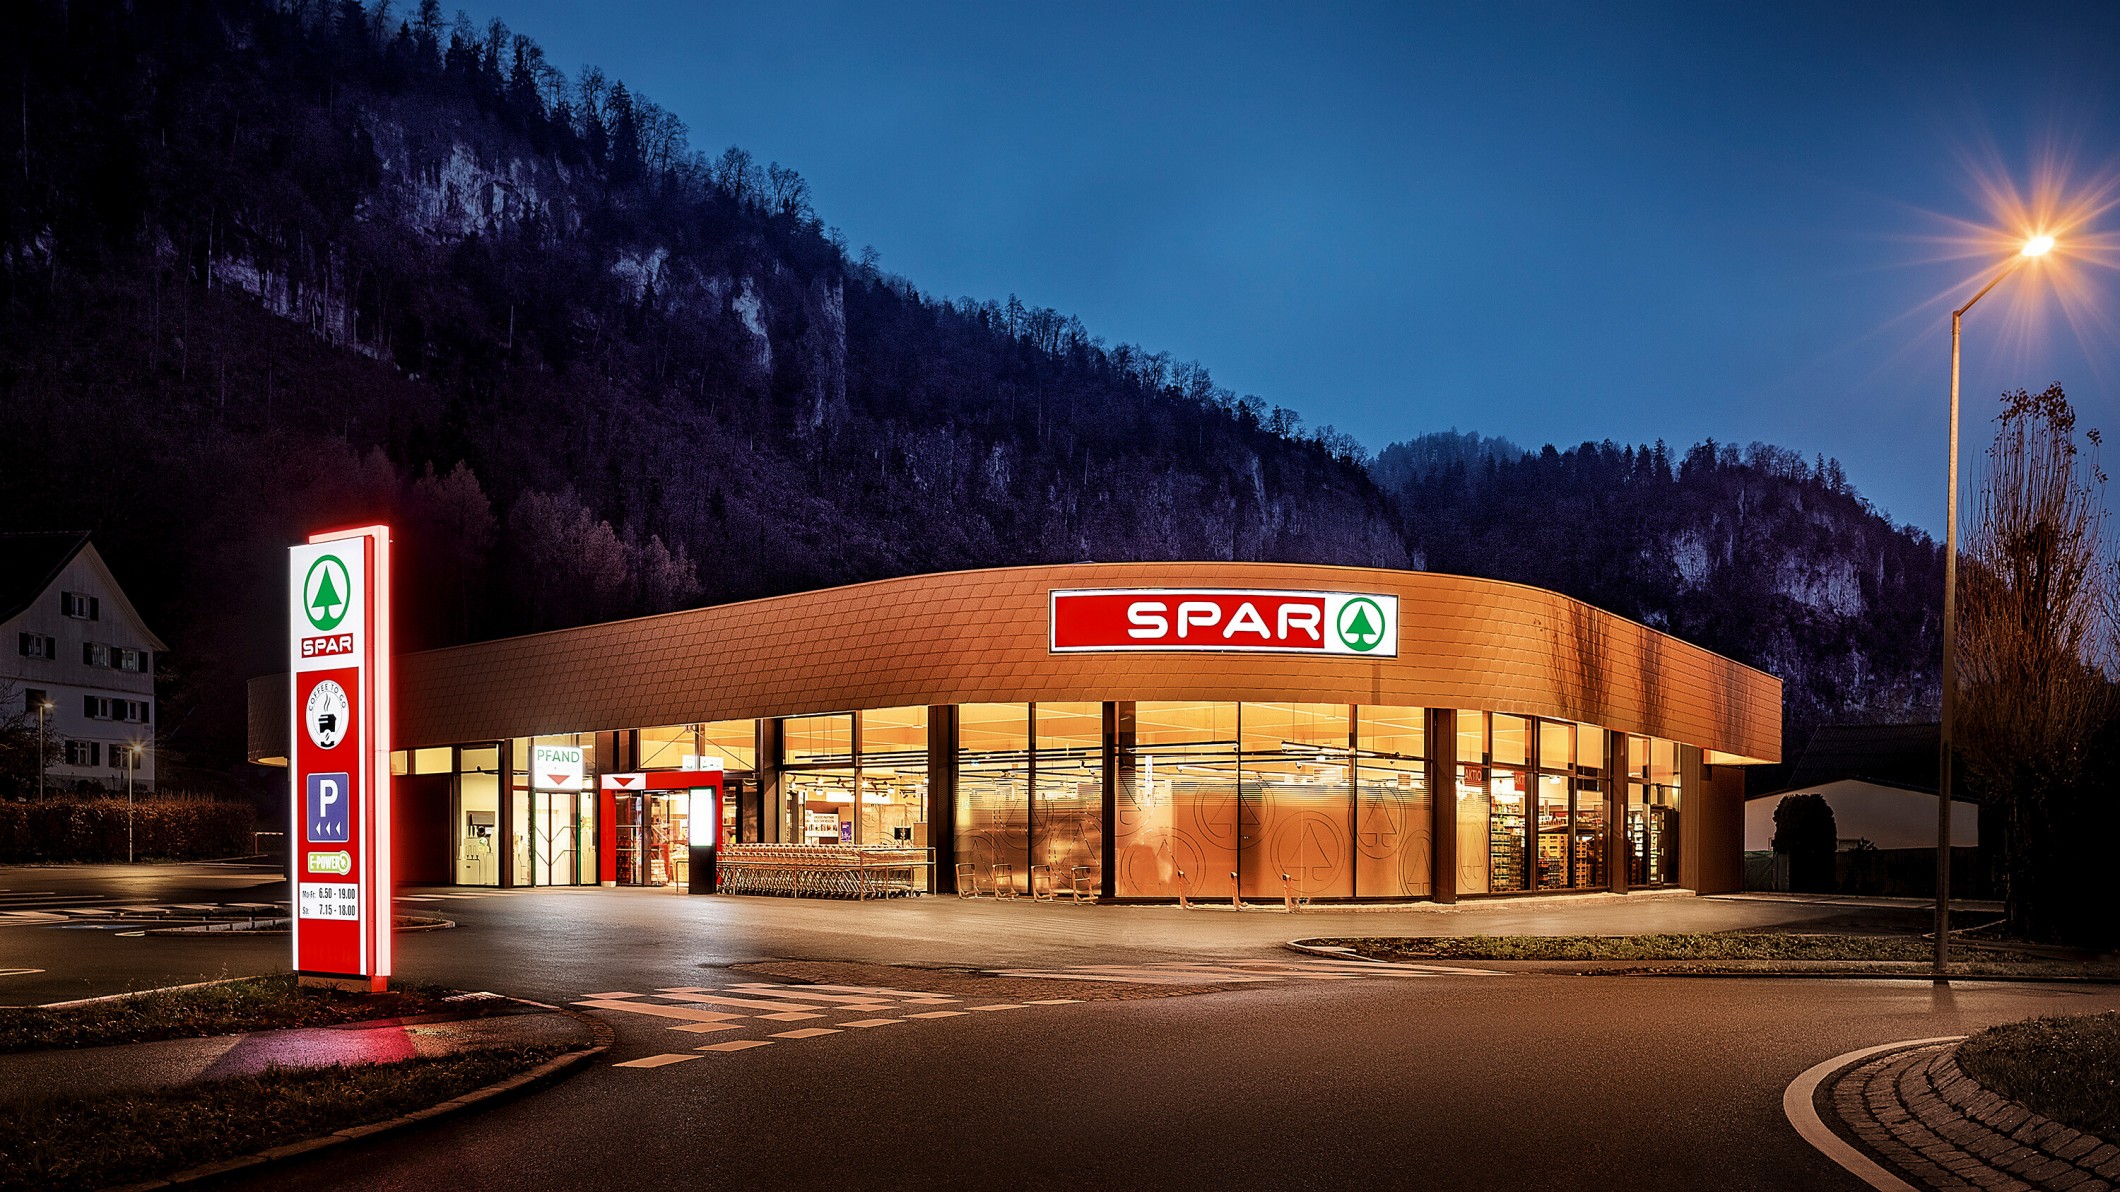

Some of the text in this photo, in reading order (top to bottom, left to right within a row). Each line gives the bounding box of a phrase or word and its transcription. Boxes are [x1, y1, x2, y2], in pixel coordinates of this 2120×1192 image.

[1127, 602, 1320, 640] SPAR
[303, 636, 352, 655] SPAR
[308, 683, 346, 711] COFFEE TO GO
[537, 749, 580, 763] PFAND
[1465, 768, 1482, 781] AKTIO
[1515, 774, 1525, 785] AKT
[319, 779, 339, 818] P
[319, 887, 332, 899] 6.50
[338, 888, 356, 900] 19.00
[319, 903, 332, 916] 7.15
[338, 904, 356, 917] 18.00
